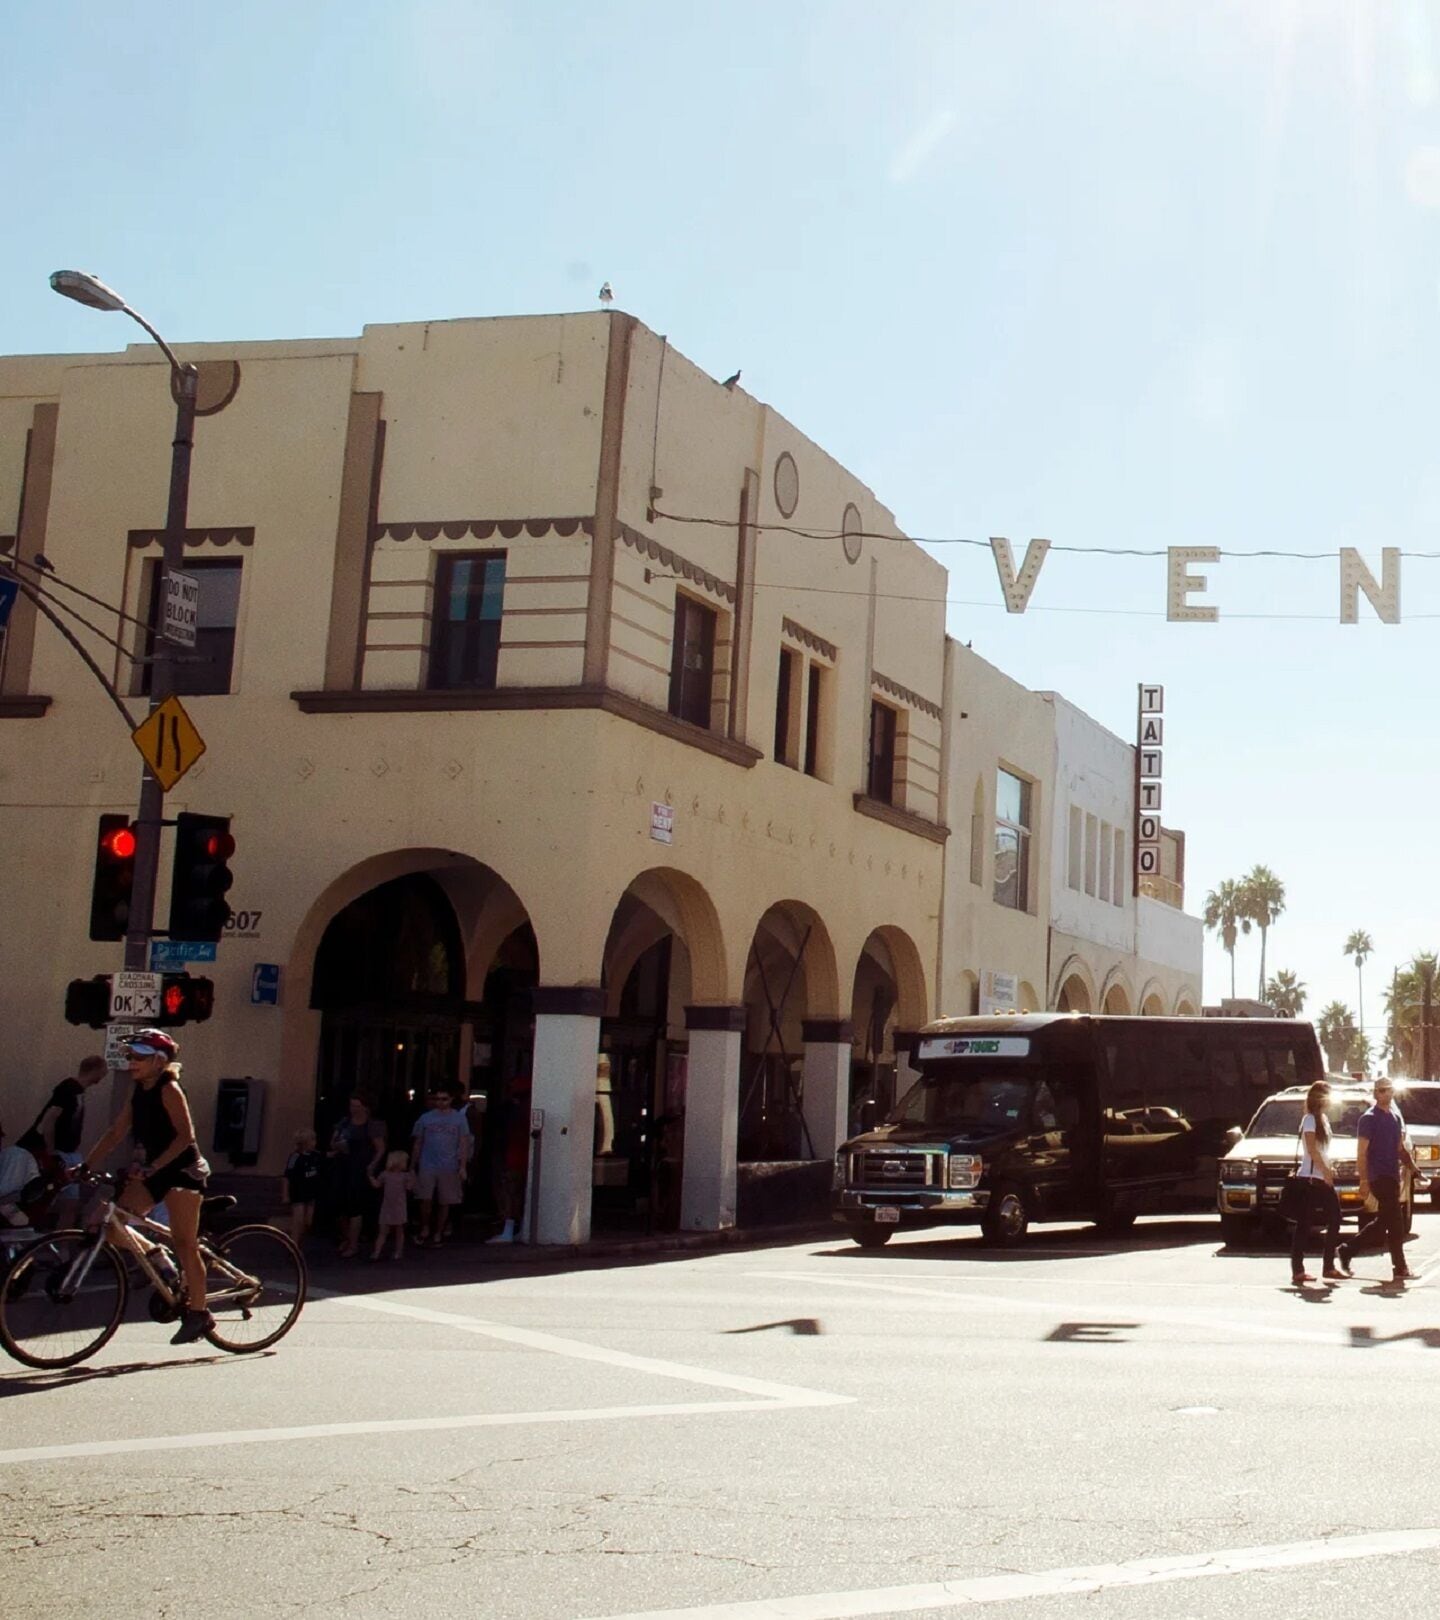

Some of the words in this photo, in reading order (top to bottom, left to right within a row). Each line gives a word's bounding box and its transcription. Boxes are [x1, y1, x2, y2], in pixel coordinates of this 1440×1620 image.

[168, 579, 180, 597] DO
[182, 584, 198, 603] NOT
[166, 602, 196, 625] BLOCK
[1140, 688, 1158, 872] TATTOO
[114, 995, 132, 1012] OK
